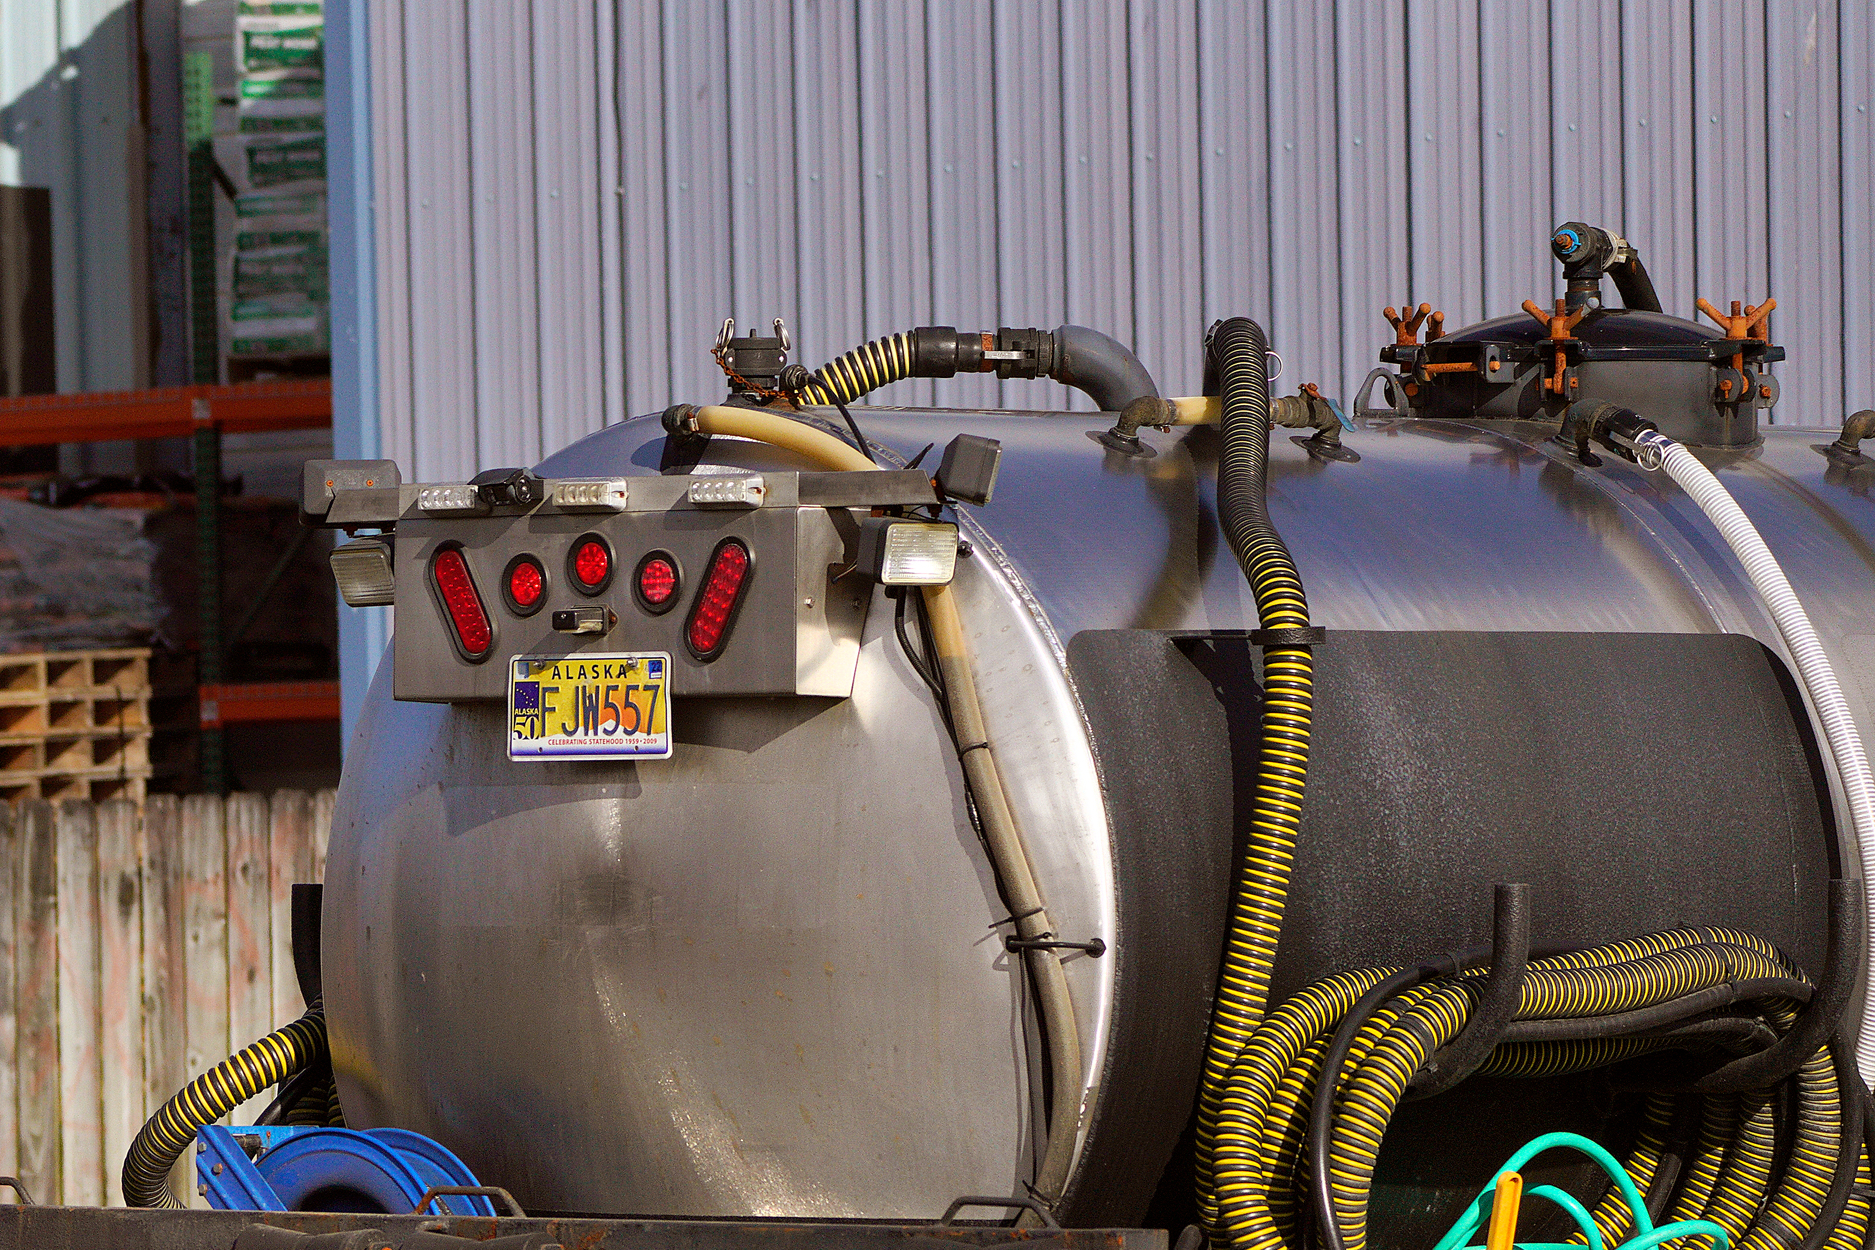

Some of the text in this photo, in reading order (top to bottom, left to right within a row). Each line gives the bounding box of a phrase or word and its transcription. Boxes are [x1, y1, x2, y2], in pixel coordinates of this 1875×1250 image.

[552, 664, 627, 680] ALASKA
[514, 708, 539, 716] ALASKA
[541, 684, 661, 738] FJW557
[513, 715, 540, 740] 50
